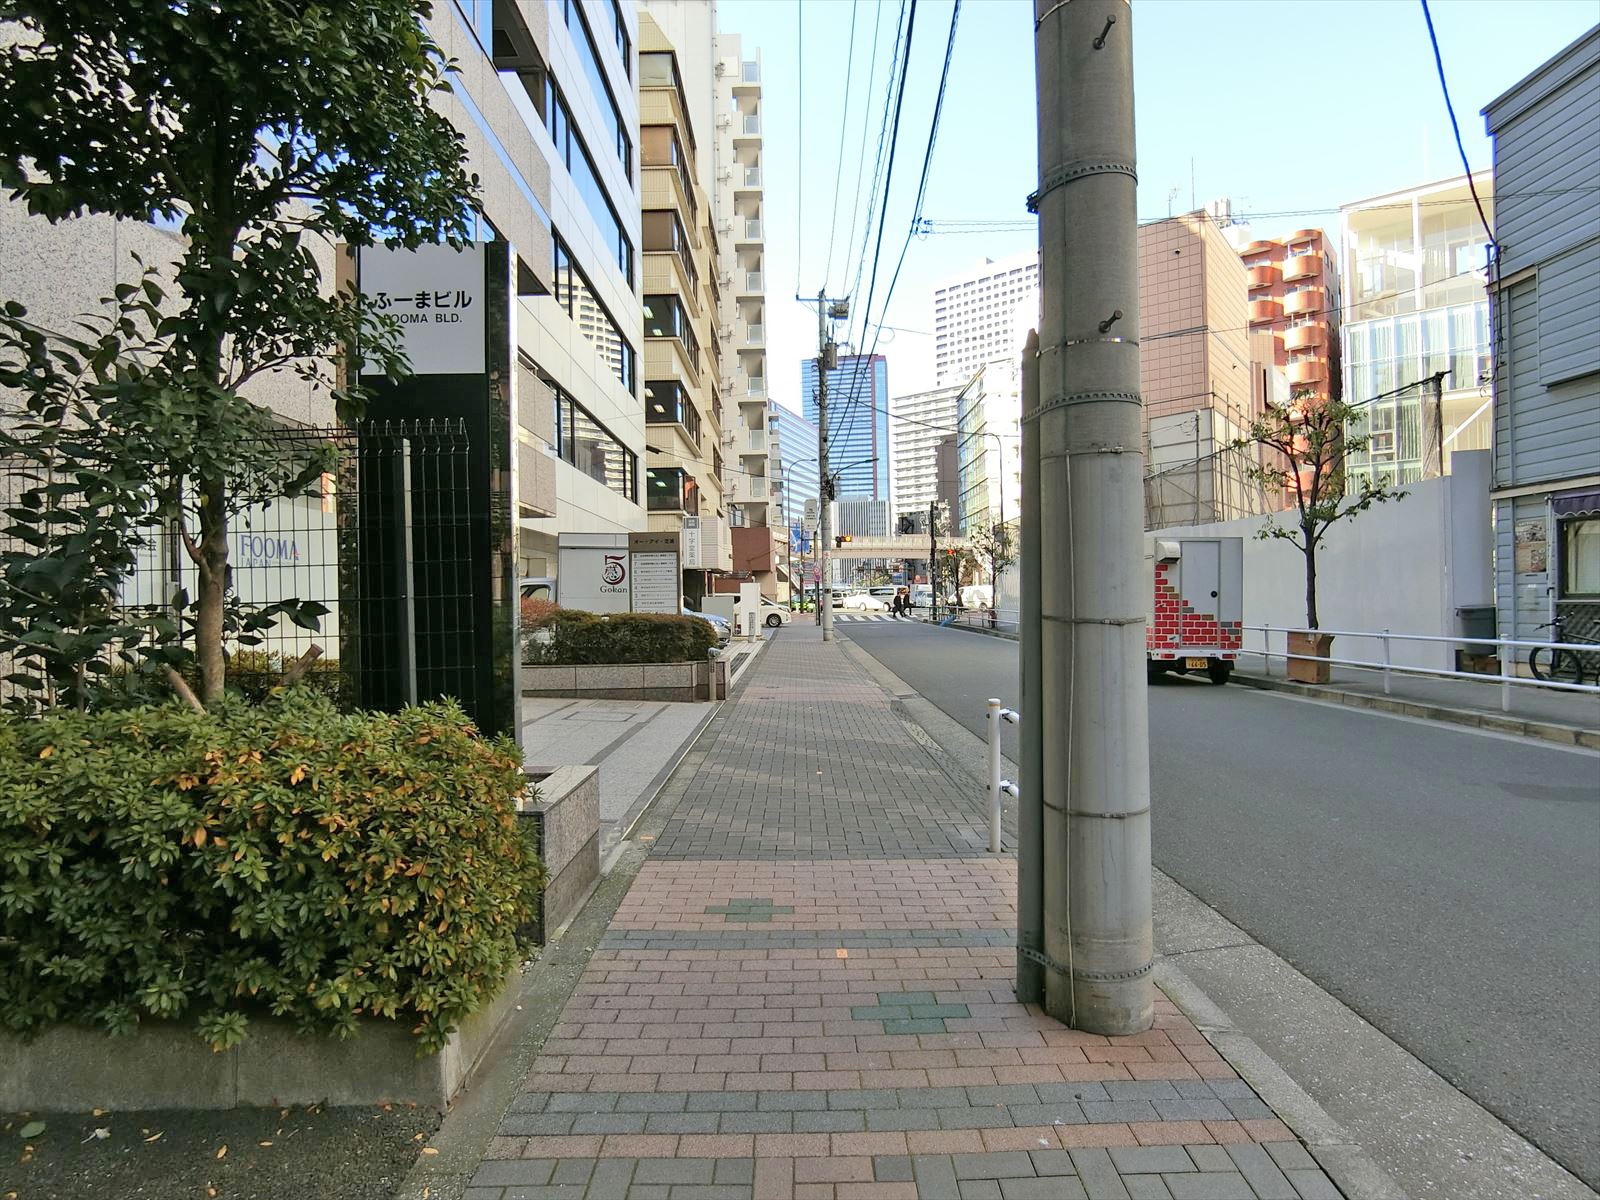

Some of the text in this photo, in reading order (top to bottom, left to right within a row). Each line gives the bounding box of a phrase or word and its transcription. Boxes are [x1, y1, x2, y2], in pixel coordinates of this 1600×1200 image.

[372, 290, 472, 309] ふーまビル
[384, 313, 462, 324] OOMA BLD.
[241, 534, 300, 561] FOOMA
[600, 585, 628, 593] Gokan
